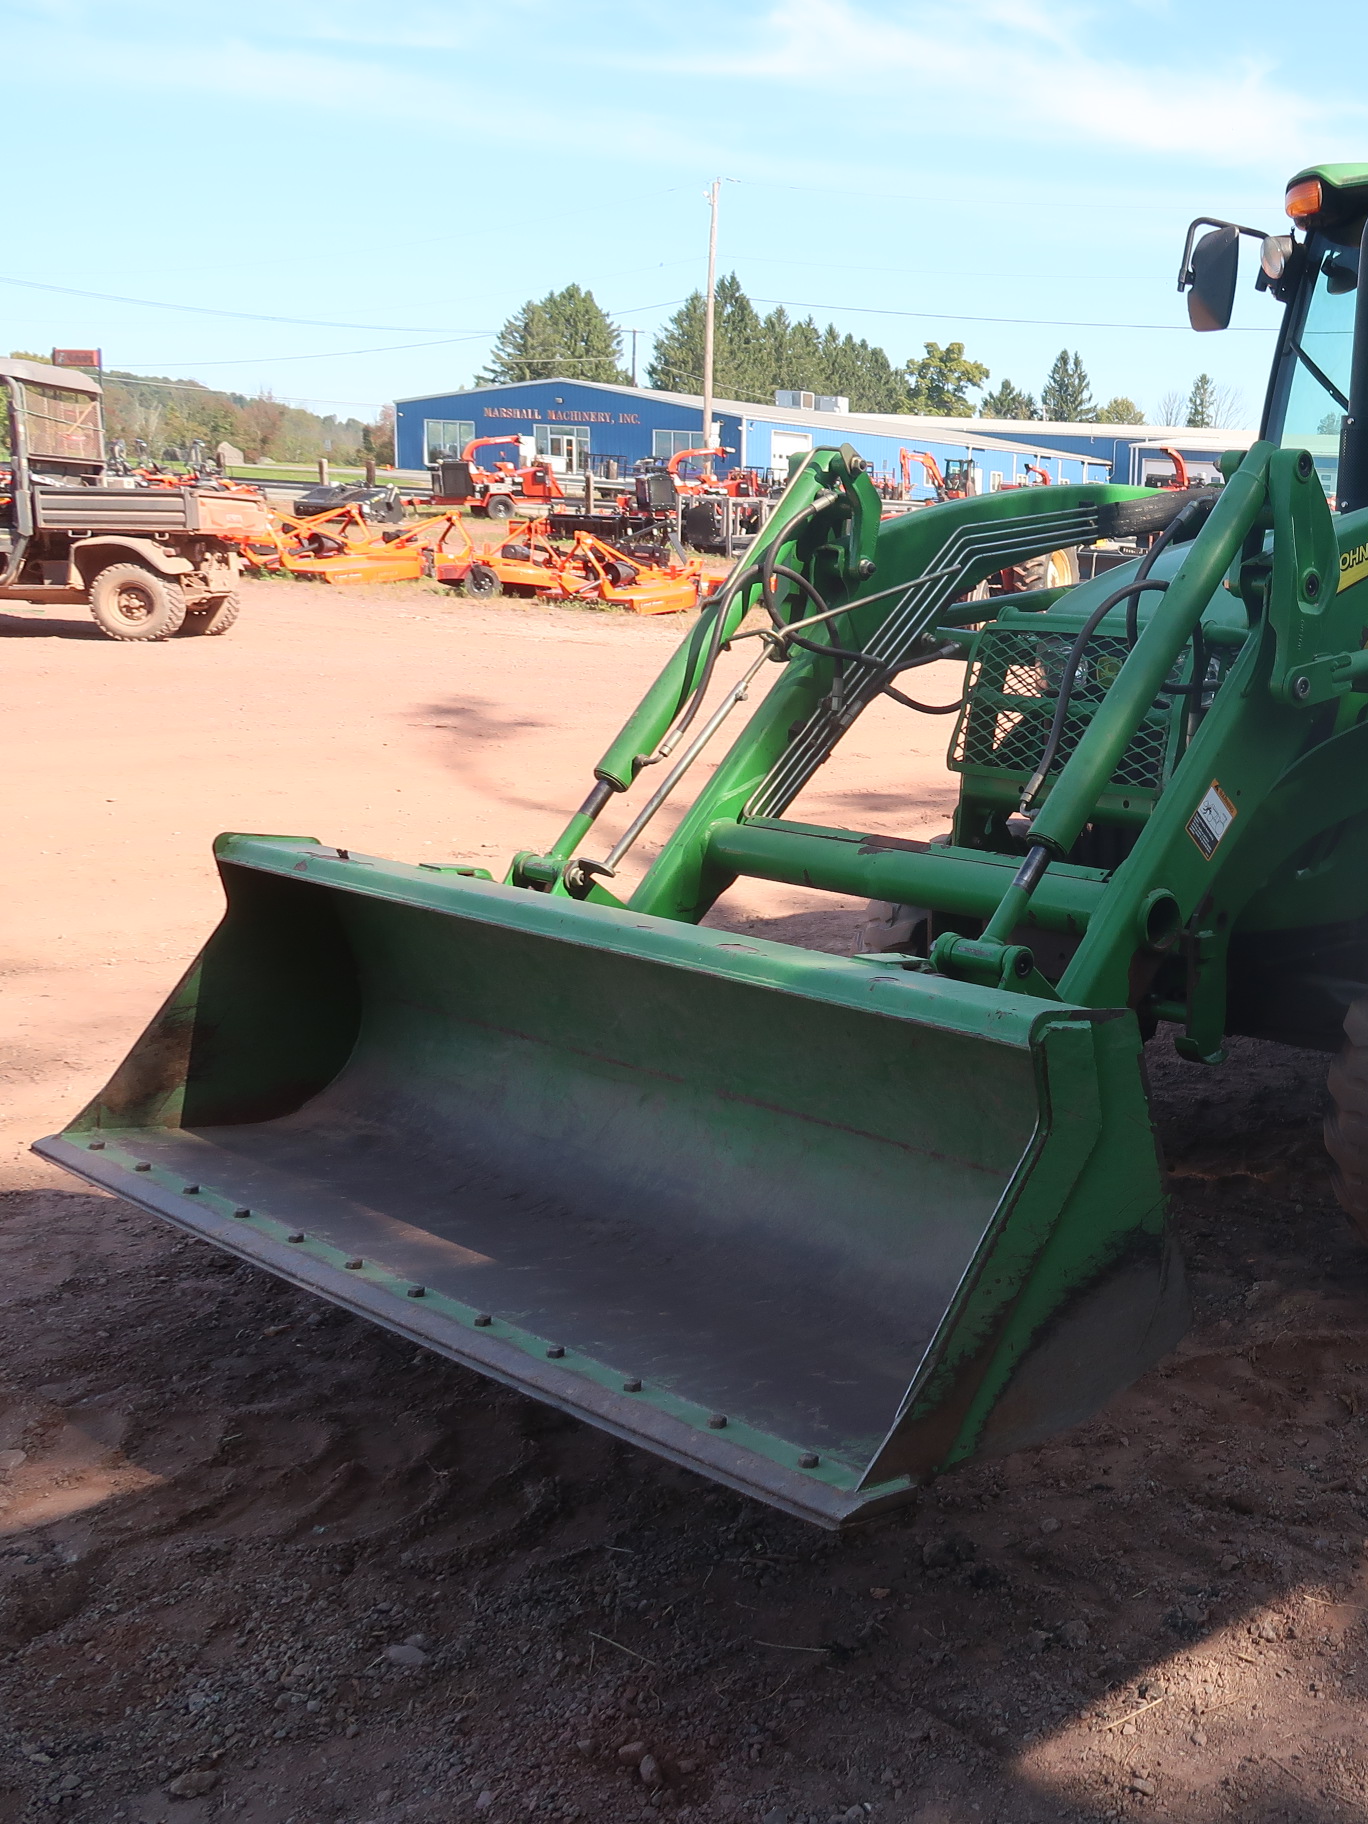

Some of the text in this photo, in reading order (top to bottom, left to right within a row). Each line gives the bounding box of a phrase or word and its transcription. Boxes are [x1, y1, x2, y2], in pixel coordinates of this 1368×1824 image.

[483, 407, 641, 424] MARSHALL MACHINERY, INC.
